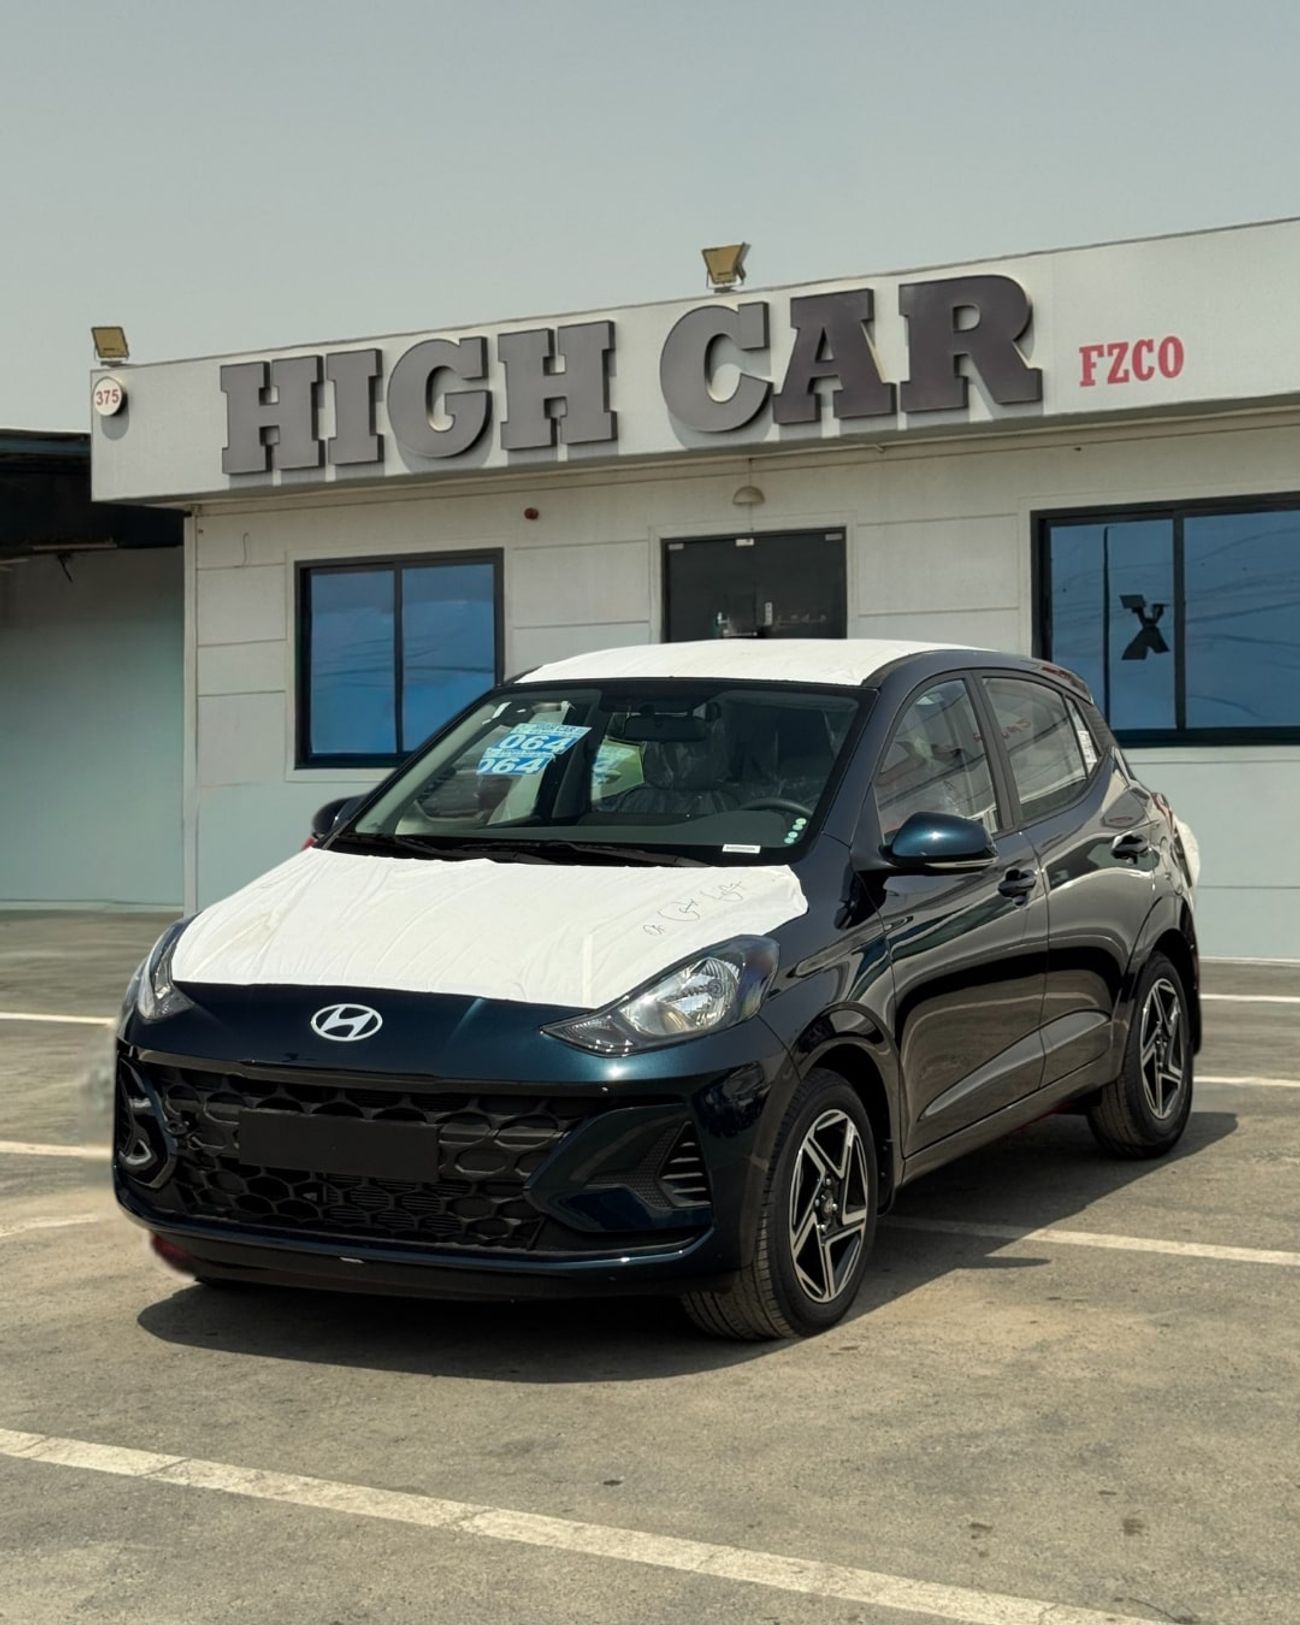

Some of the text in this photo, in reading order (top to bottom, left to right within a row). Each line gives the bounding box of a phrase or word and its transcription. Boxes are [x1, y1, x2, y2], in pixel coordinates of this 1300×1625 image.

[220, 274, 1043, 474] HIGH CAR
[1079, 336, 1184, 387] FZCO
[95, 388, 121, 407] 375
[499, 734, 574, 754] 064
